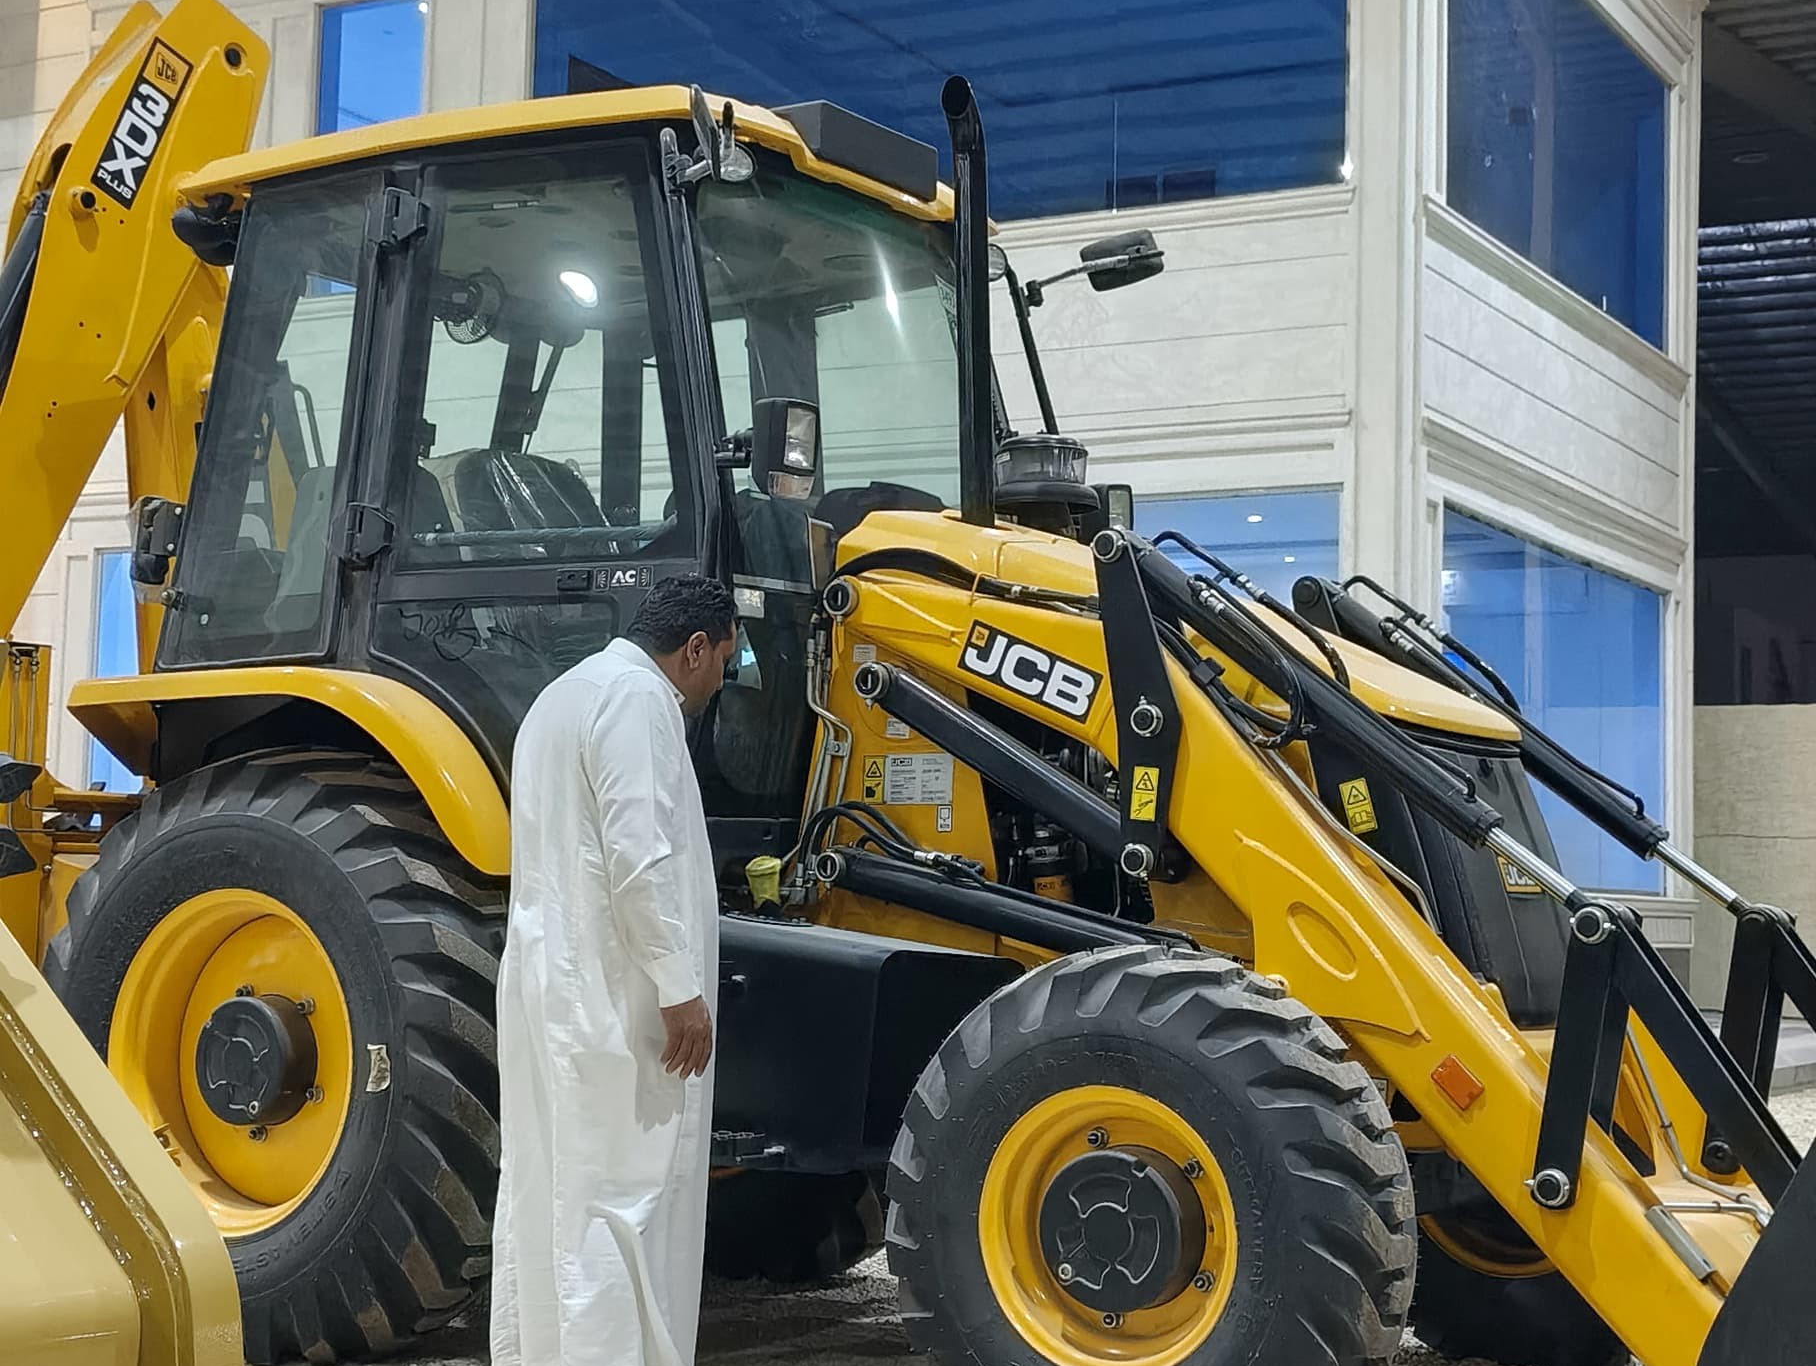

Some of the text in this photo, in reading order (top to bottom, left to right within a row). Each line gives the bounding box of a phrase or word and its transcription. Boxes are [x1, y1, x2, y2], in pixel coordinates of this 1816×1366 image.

[157, 57, 177, 83] JCB
[100, 83, 170, 191] 3DX
[97, 168, 134, 200] PLUS
[610, 569, 637, 584] AC
[963, 633, 1096, 717] JCB
